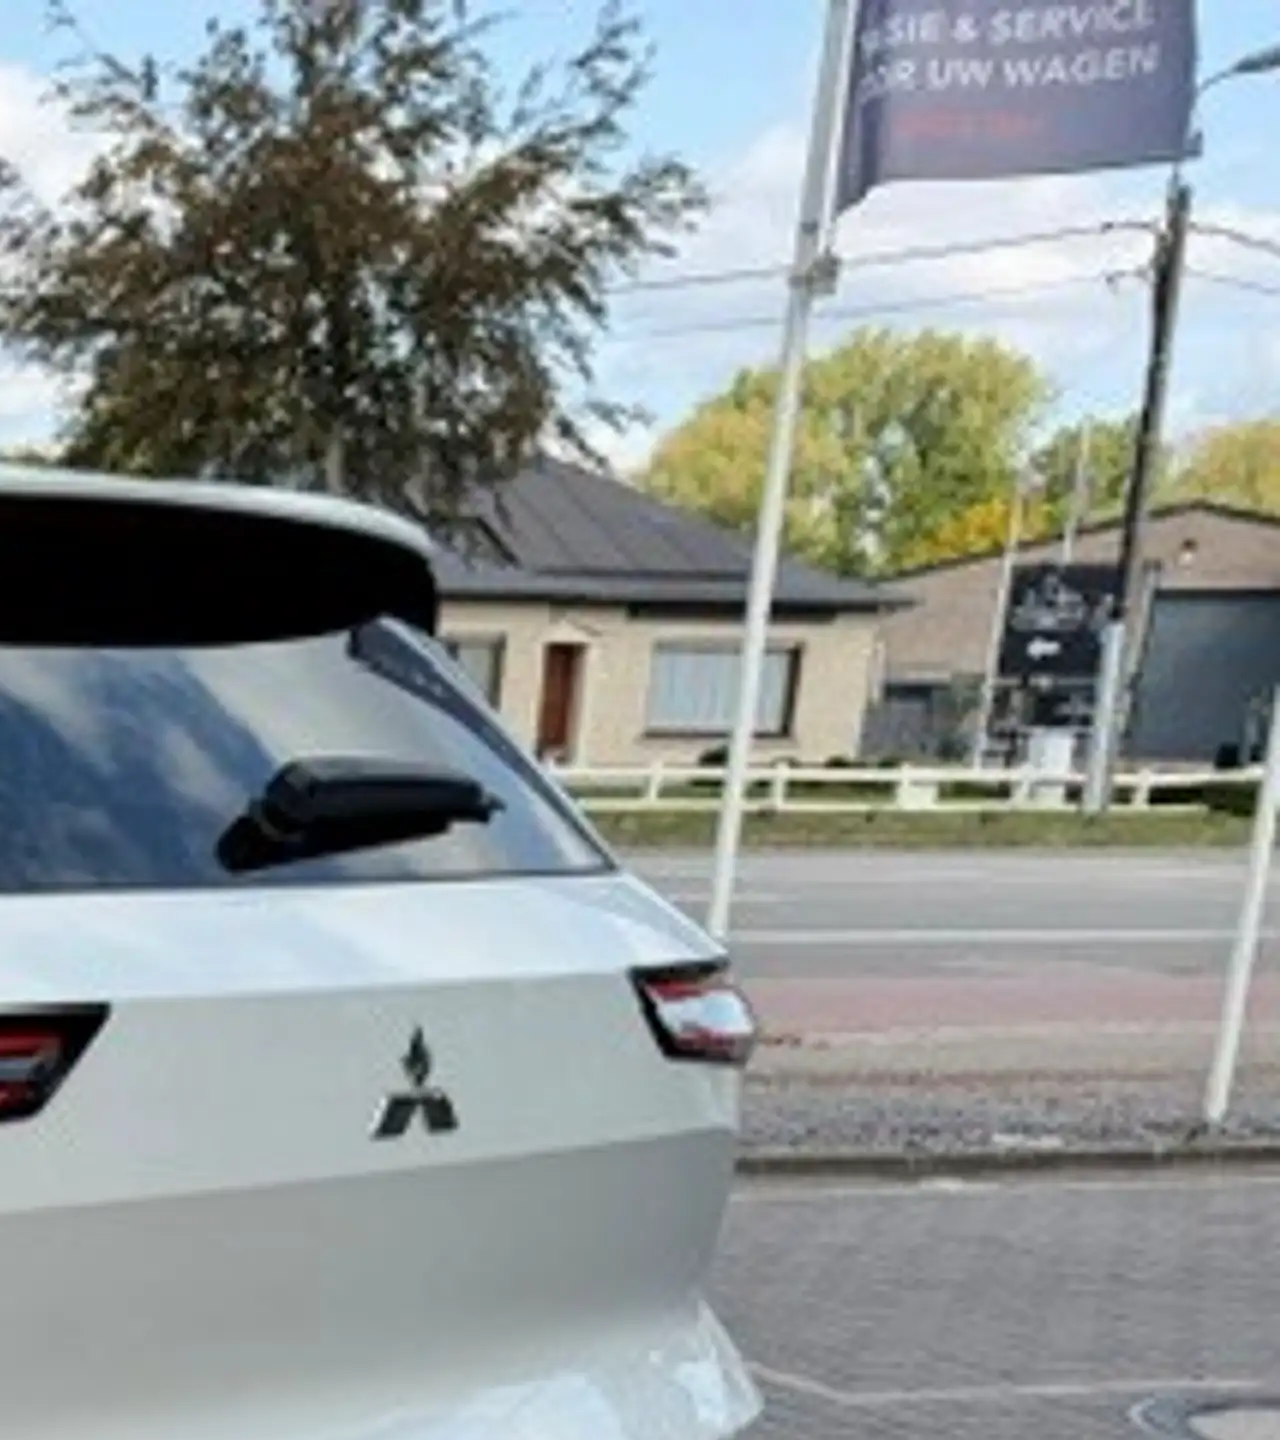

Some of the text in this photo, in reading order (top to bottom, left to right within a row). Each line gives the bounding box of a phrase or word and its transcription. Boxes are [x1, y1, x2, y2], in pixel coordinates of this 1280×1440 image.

[991, 0, 1156, 47] SERVICE
[927, 56, 992, 91] UW
[1003, 41, 1162, 87] WAGEN
